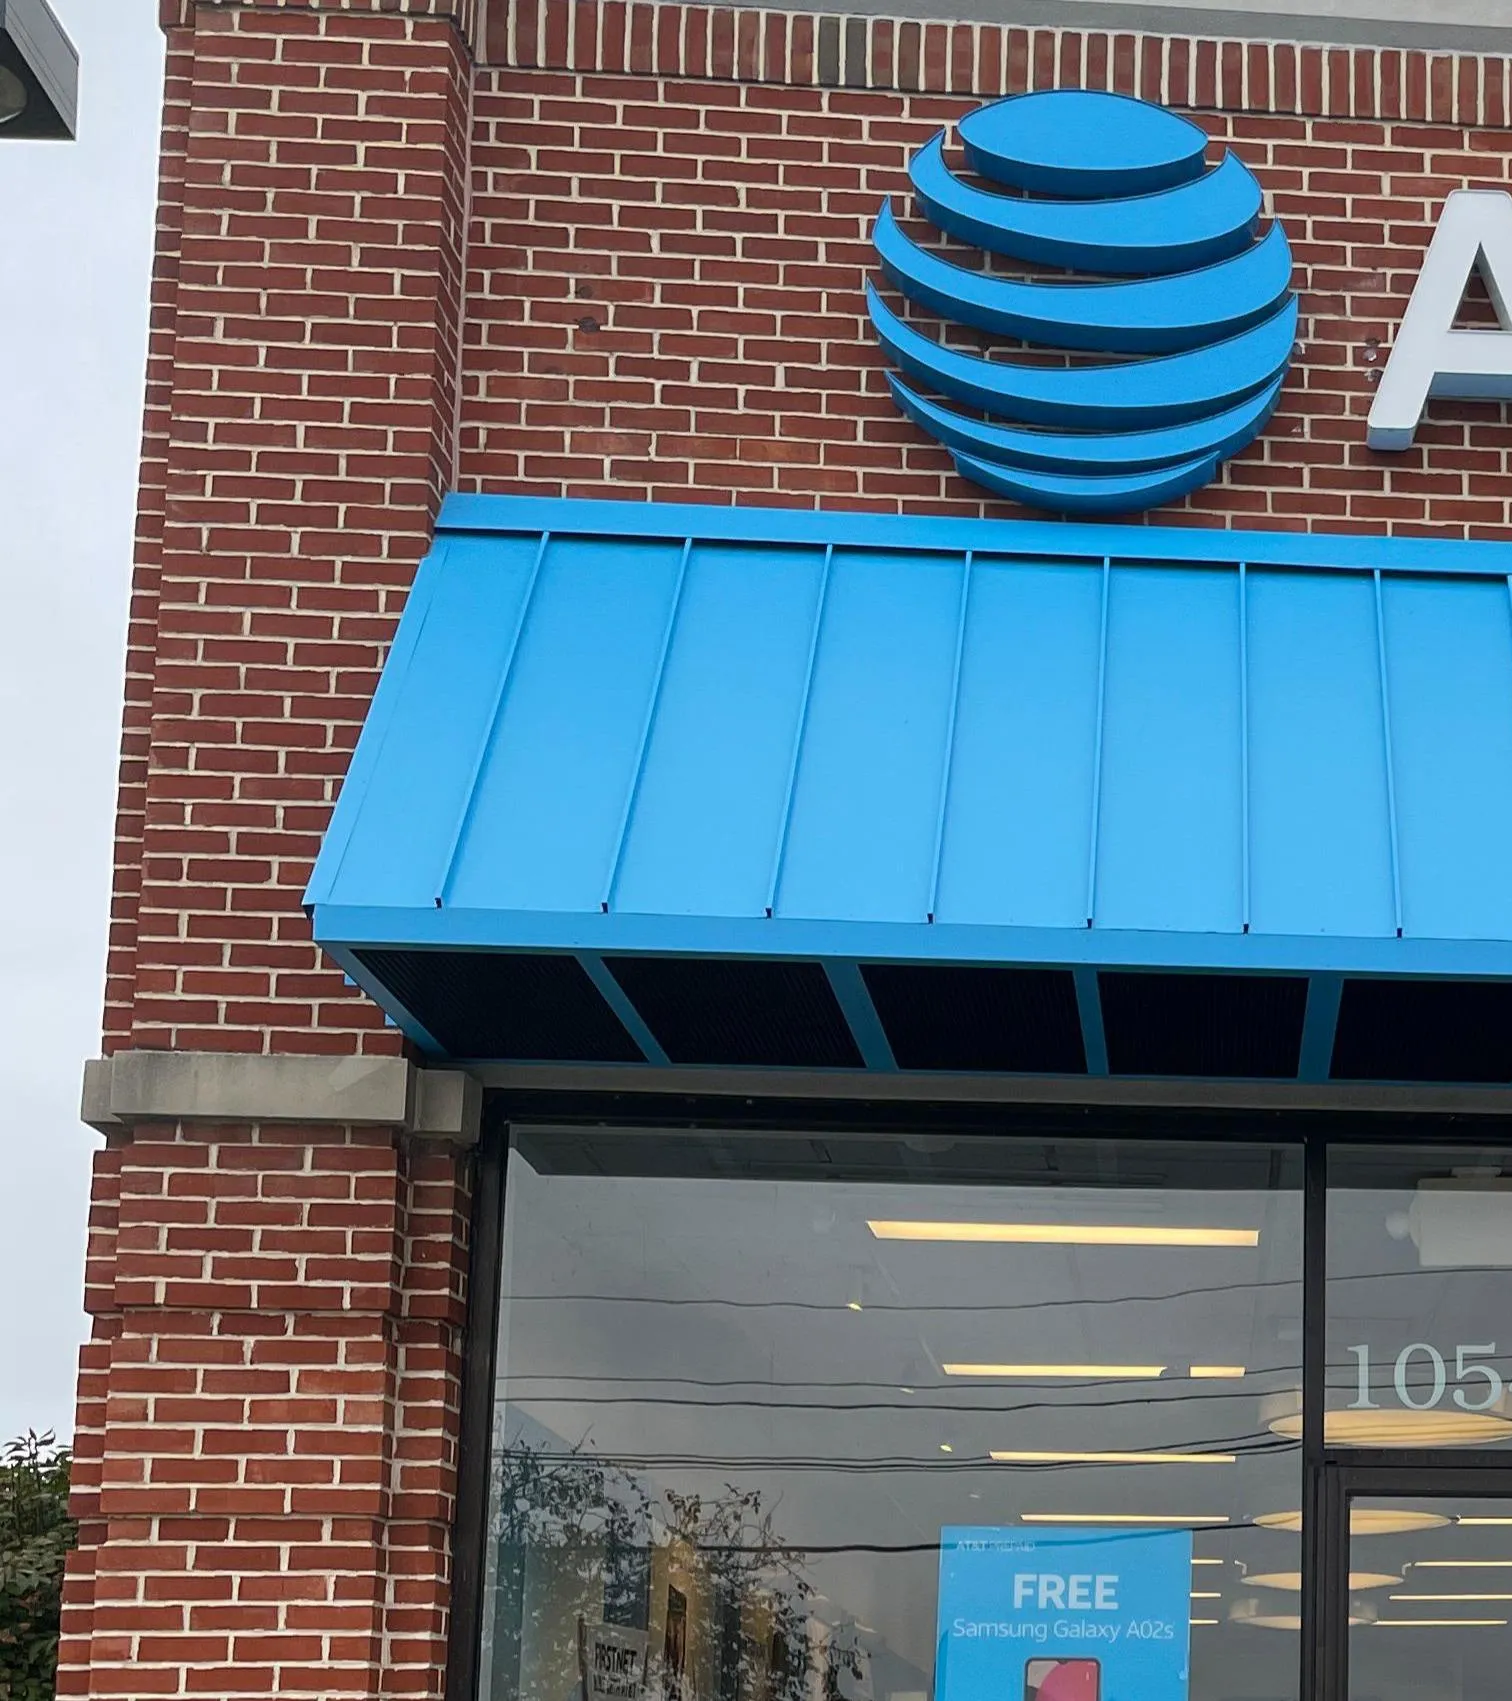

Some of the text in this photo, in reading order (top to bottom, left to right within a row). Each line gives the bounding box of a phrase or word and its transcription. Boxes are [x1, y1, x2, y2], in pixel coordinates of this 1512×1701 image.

[1013, 1573, 1119, 1610] FREE
[952, 1618, 1175, 1643] Samsung Galaxy A02s
